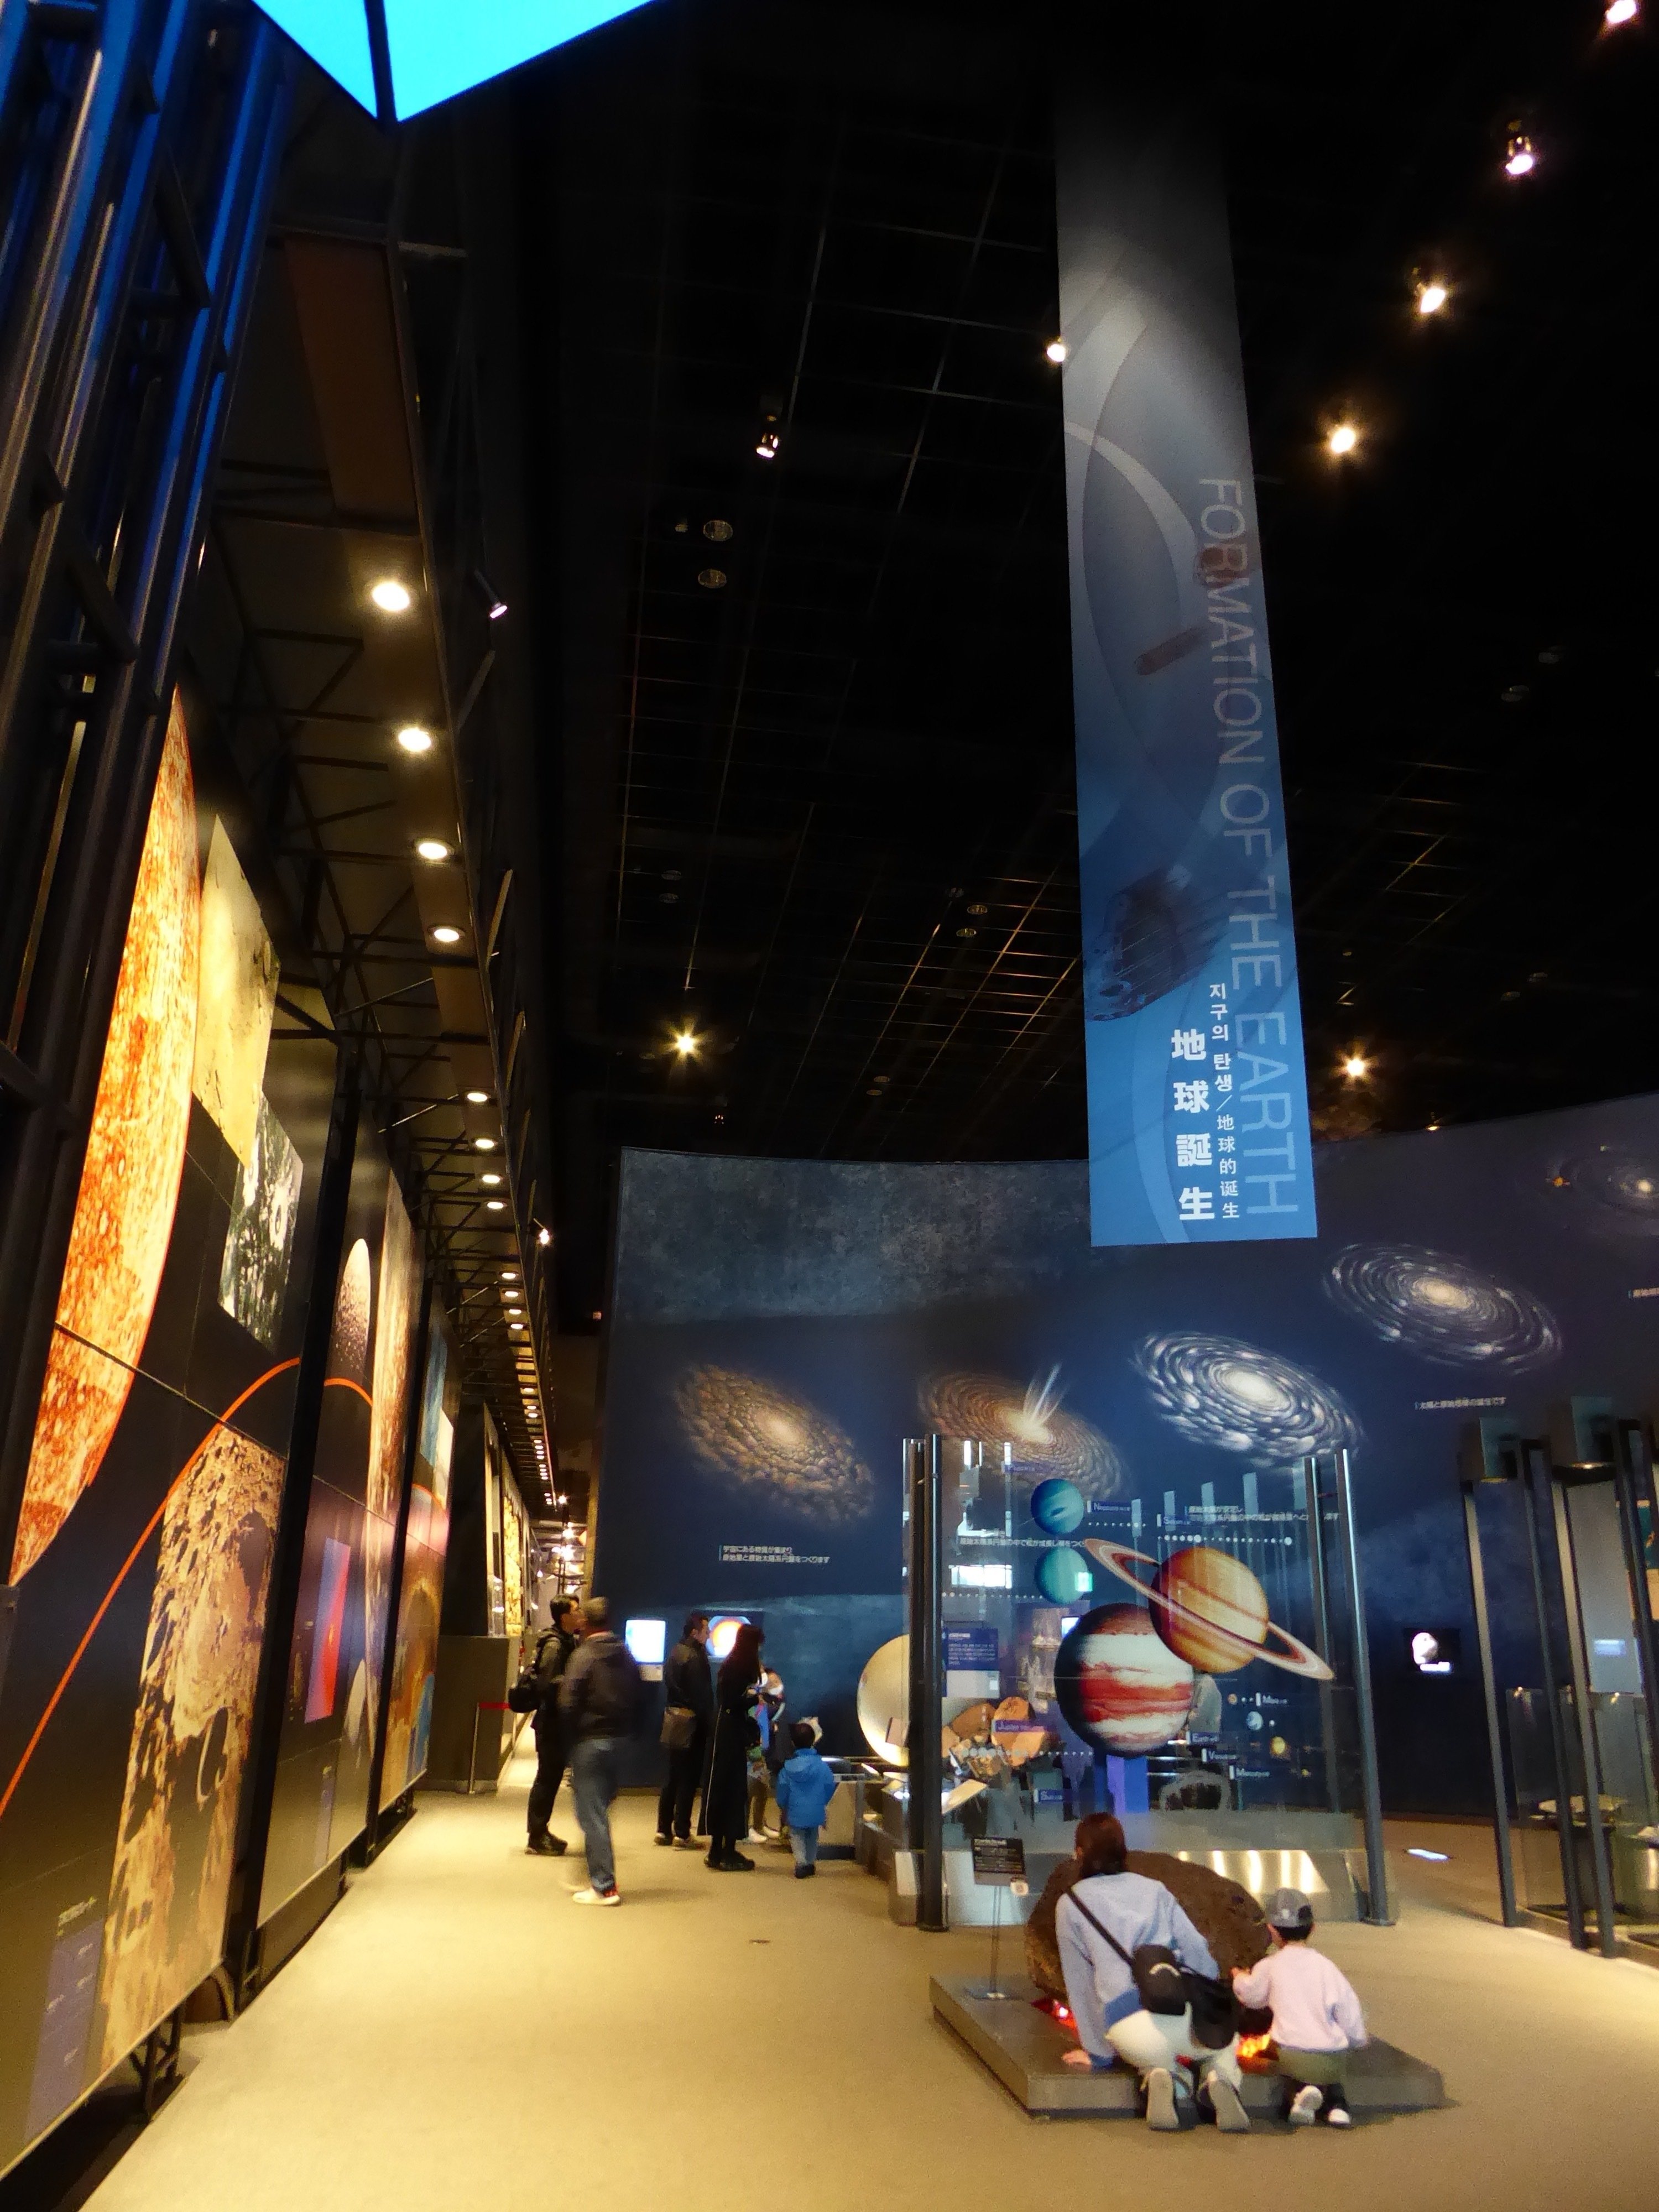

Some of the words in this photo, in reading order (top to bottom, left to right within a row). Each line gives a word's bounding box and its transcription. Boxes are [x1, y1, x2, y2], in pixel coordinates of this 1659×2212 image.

[1198, 478, 1265, 765] FORMATION
[1220, 784, 1272, 857] OF
[1228, 875, 1282, 990] THE
[1209, 983, 1229, 1041] 지구의
[1171, 1029, 1215, 1220] 地球誕生
[1234, 1011, 1298, 1215] EARTH
